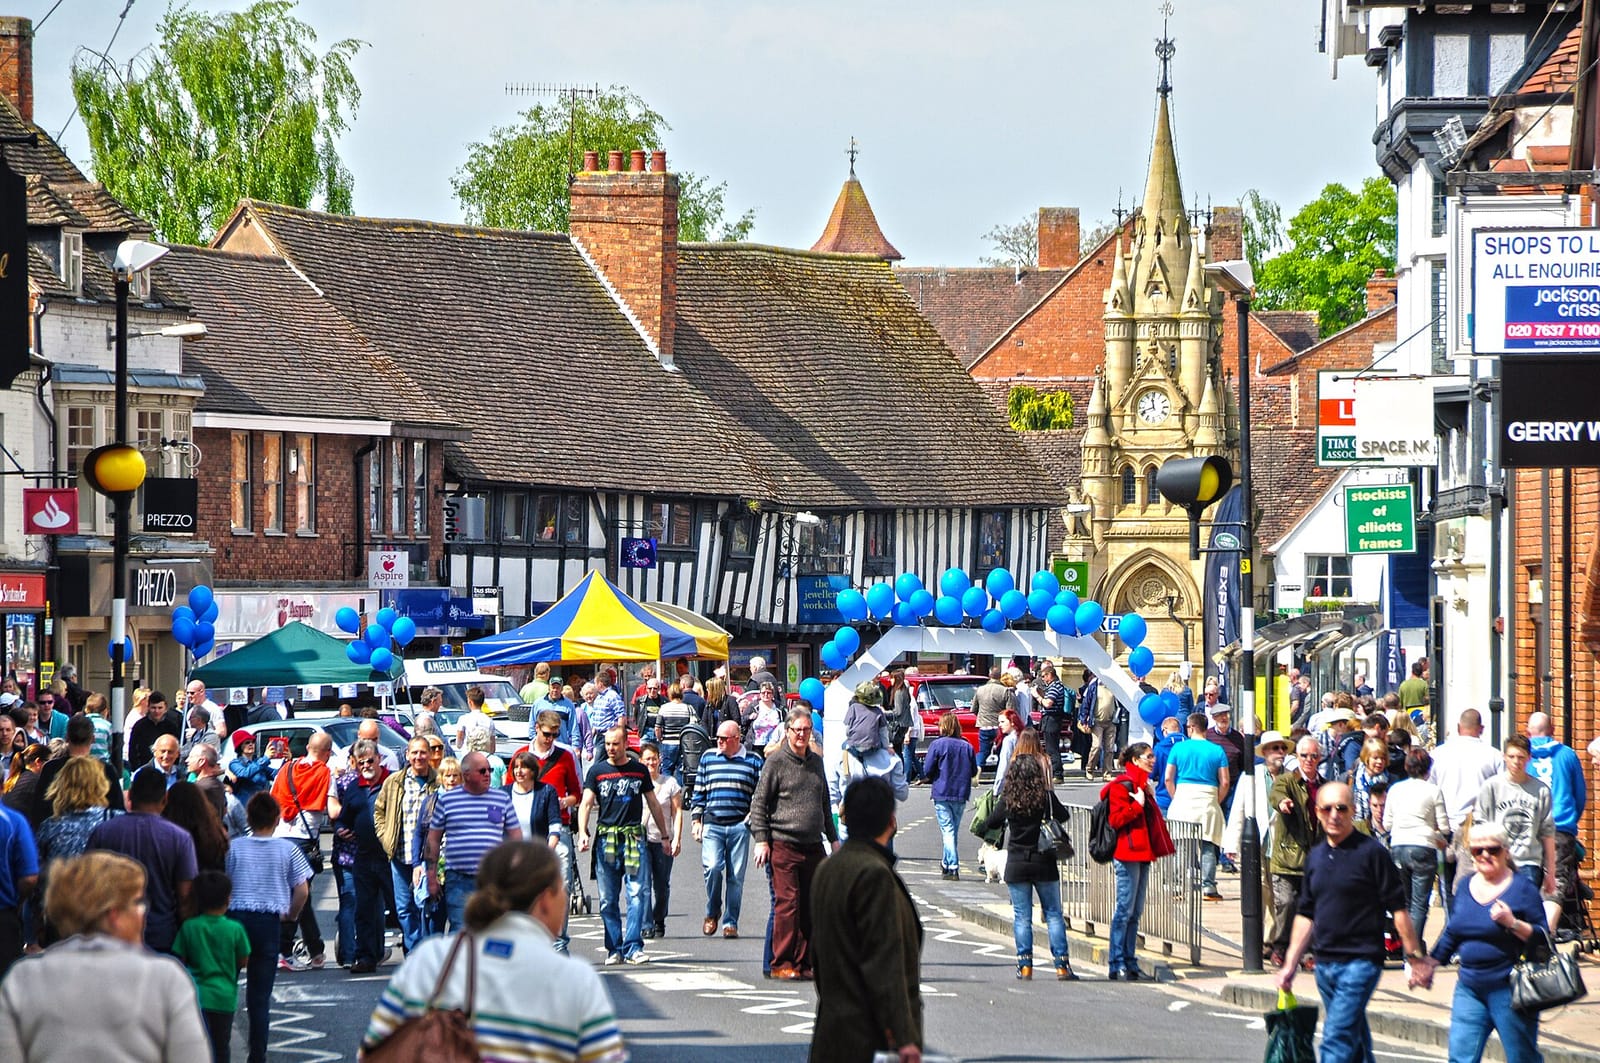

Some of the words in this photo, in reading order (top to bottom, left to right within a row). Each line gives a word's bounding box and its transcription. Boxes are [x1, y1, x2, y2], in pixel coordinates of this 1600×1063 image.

[1484, 236, 1552, 255] SHOPS
[1557, 236, 1583, 254] TO
[1493, 264, 1525, 279] ALL
[1534, 287, 1600, 306] jackson
[1507, 324, 1532, 337] 020
[1534, 324, 1566, 337] 7637
[1567, 324, 1600, 337] 7100
[1338, 401, 1356, 419] L
[1507, 421, 1584, 442] GERRY
[1326, 438, 1349, 449] TIM
[1351, 489, 1407, 502] stockists
[1372, 505, 1387, 517] of
[147, 513, 193, 528] PREZZO
[1357, 521, 1403, 534] elliotts
[1359, 538, 1403, 550] frames
[373, 571, 404, 582] Aspire
[137, 568, 177, 607] PREZZO
[815, 579, 829, 588] the
[1060, 584, 1081, 592] OXFAM
[3, 582, 28, 603] Santander
[485, 587, 497, 596] stop
[804, 588, 838, 601] jeweller
[289, 600, 314, 622] Aspire
[427, 659, 476, 672] AMBULANCE
